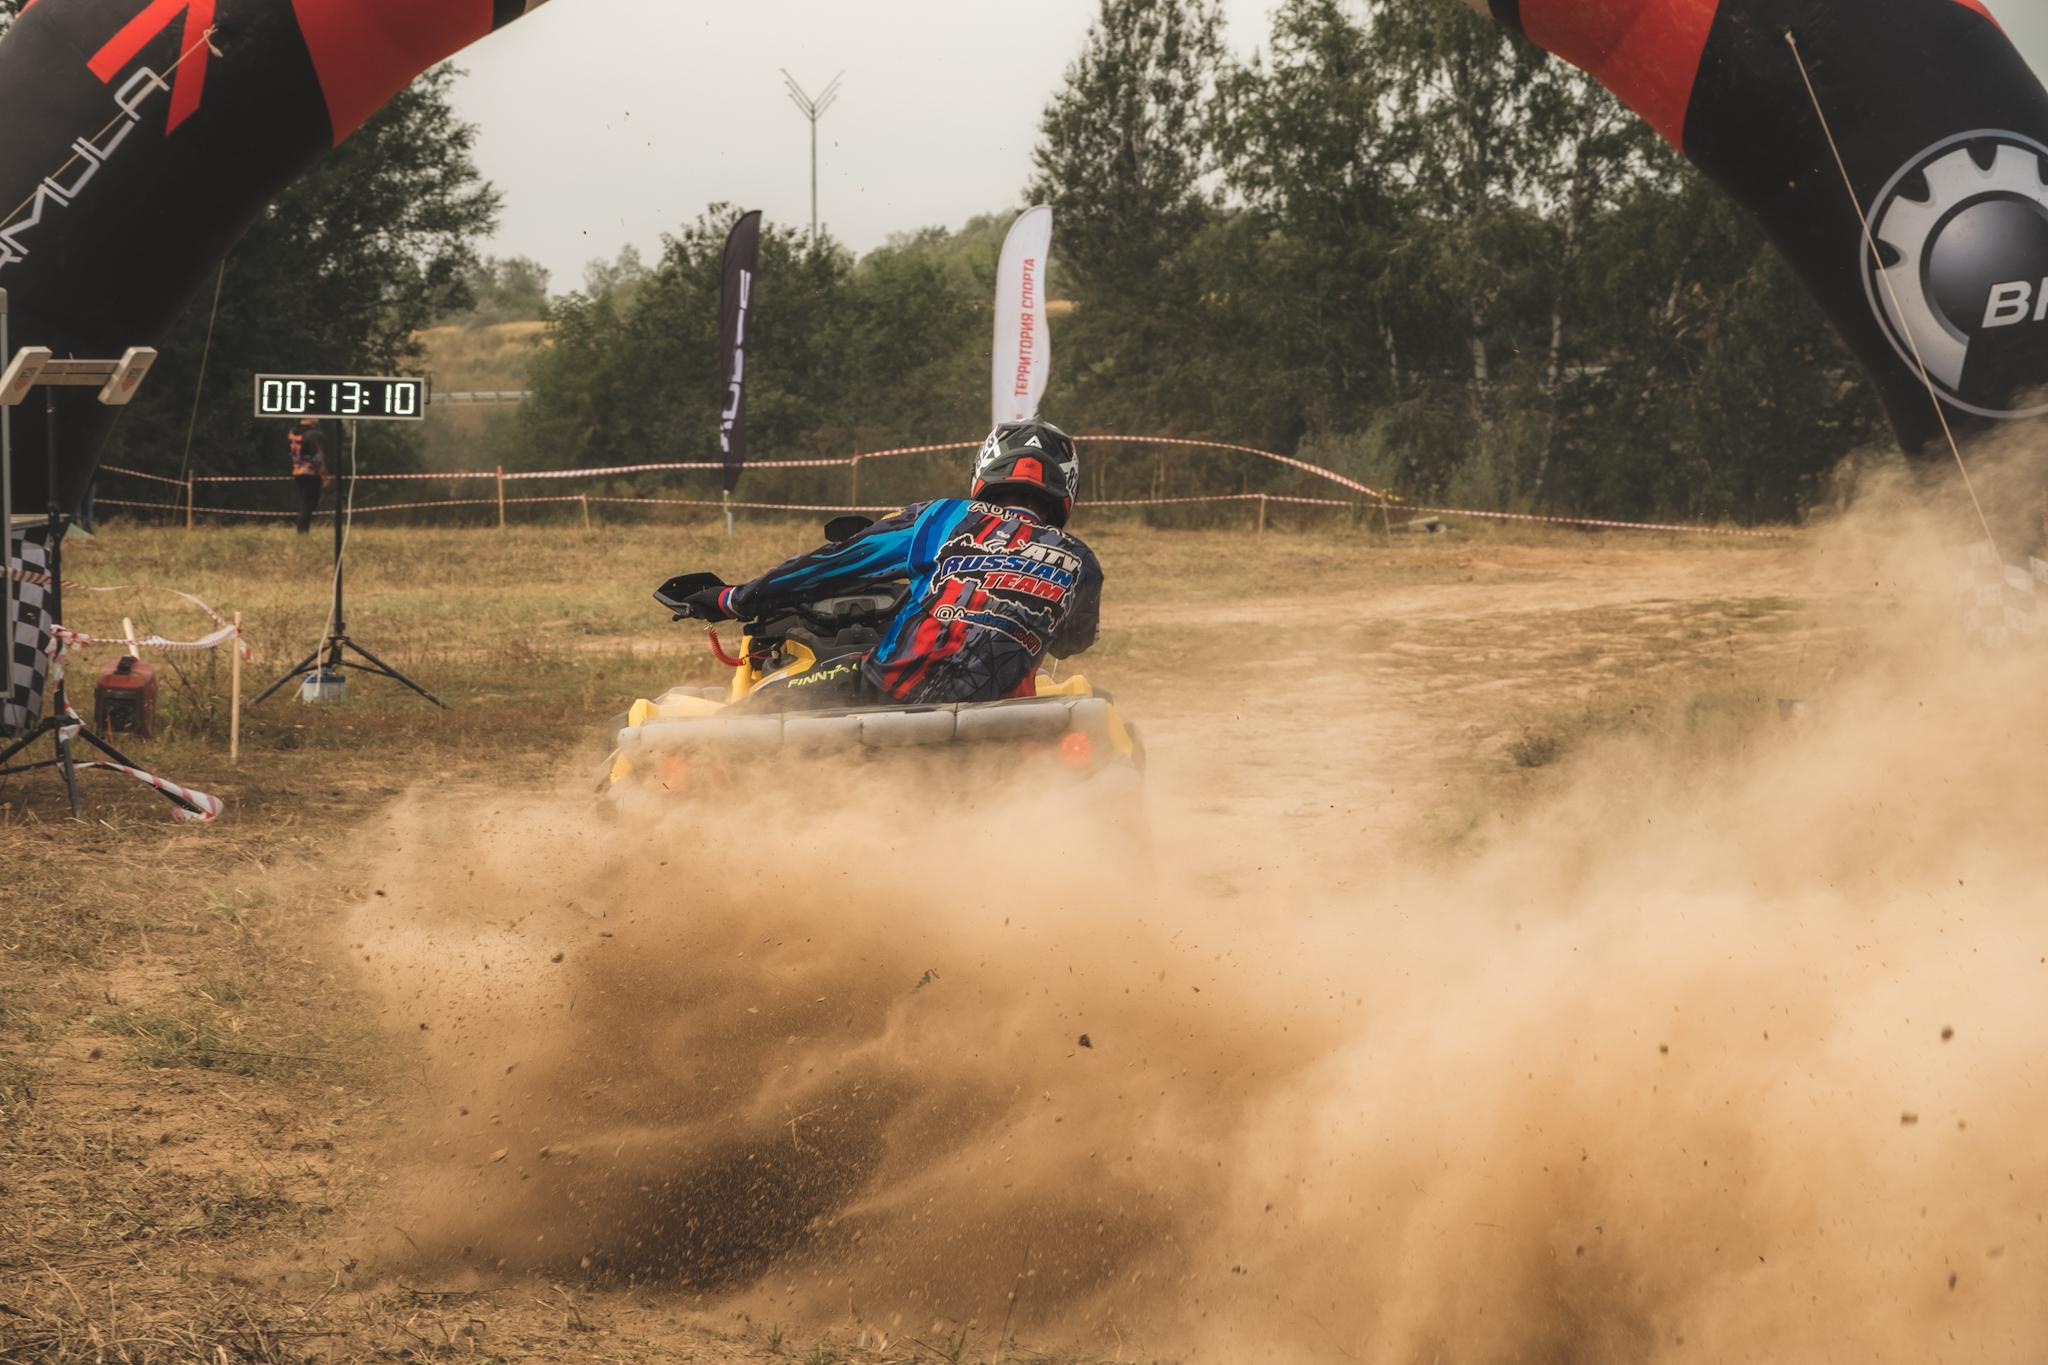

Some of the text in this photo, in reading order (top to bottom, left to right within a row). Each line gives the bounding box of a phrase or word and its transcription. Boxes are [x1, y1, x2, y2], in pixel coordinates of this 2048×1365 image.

[1022, 258, 1035, 308] СПОРТА
[1014, 313, 1034, 397] ТЕРРИТОРИЯ
[262, 380, 415, 415] 00:13:10
[940, 555, 1073, 588] RUSSIAN
[1020, 544, 1080, 573] ATV
[982, 571, 1067, 603] TEAM
